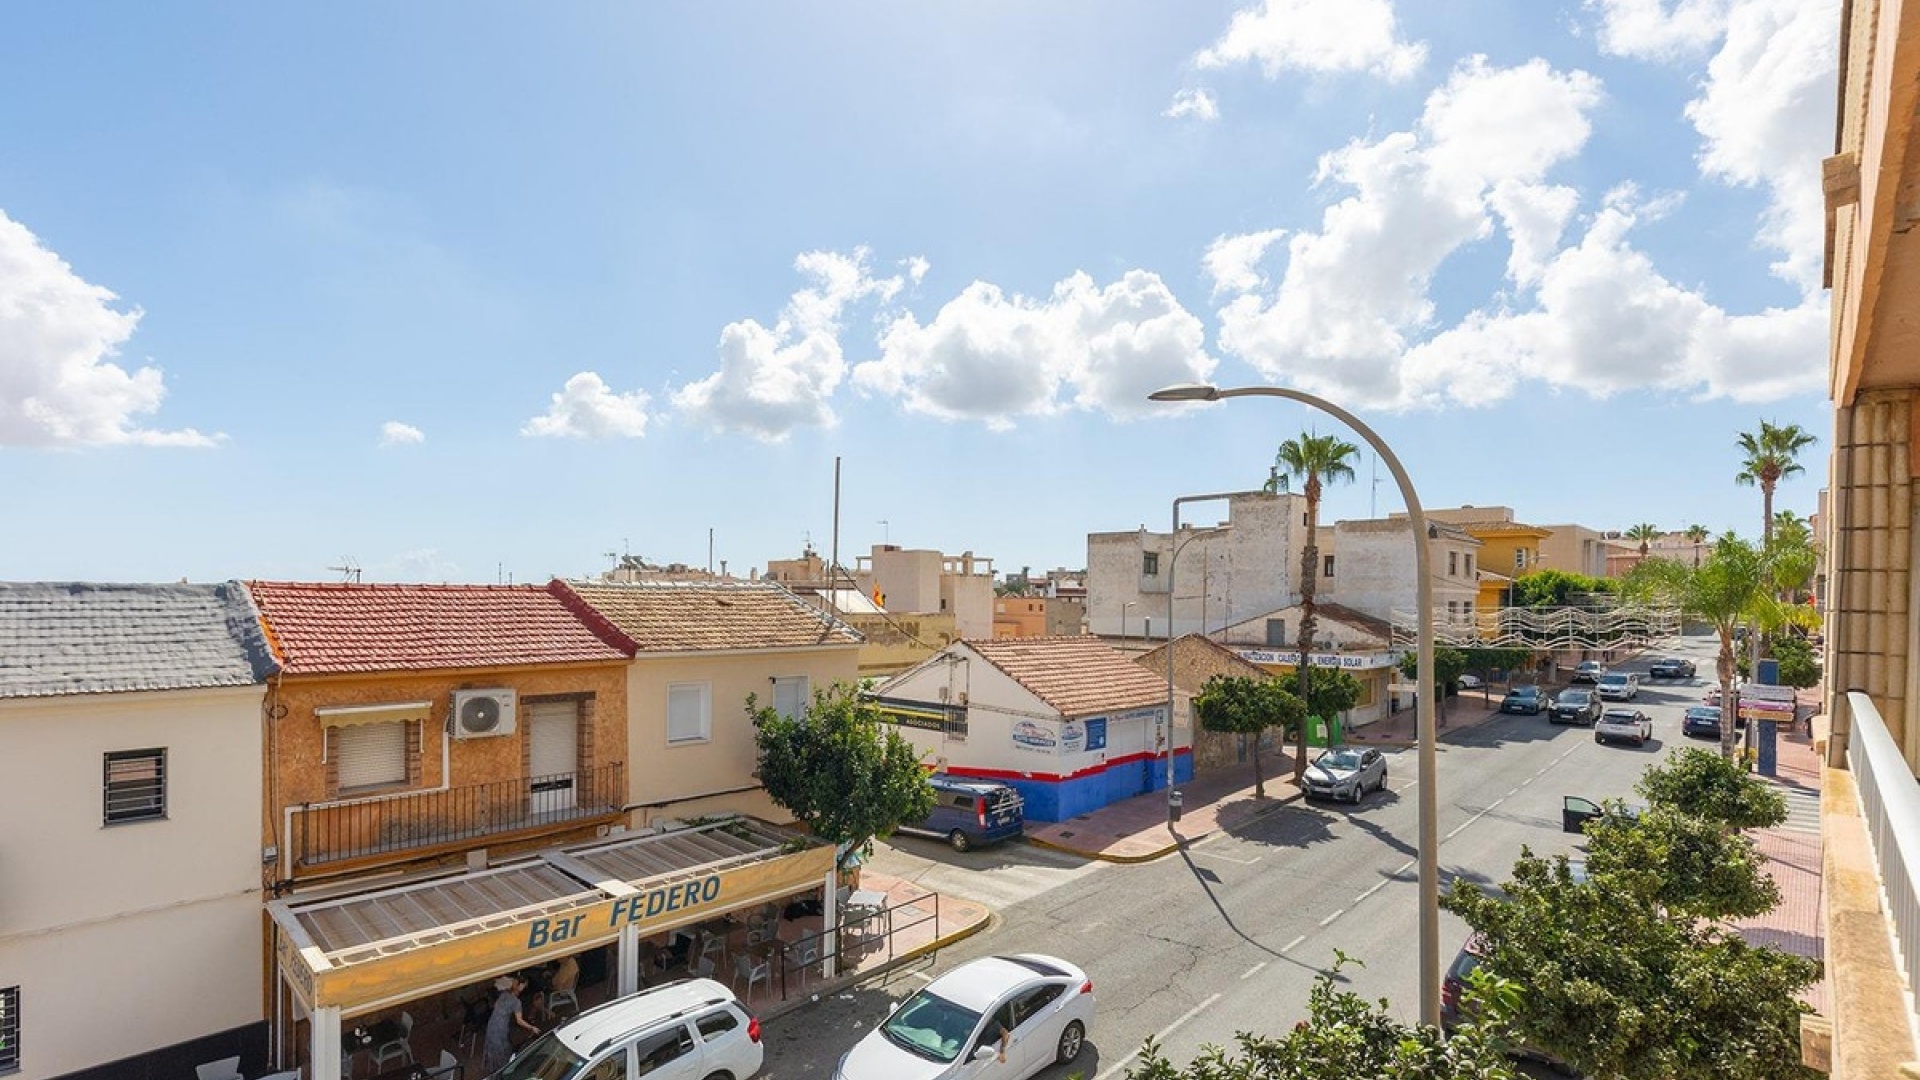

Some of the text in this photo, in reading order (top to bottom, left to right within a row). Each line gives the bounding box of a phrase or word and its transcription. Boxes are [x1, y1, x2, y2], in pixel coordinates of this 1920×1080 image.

[1343, 657, 1363, 667] SOLAR
[528, 875, 721, 949] Bar FEDERO
